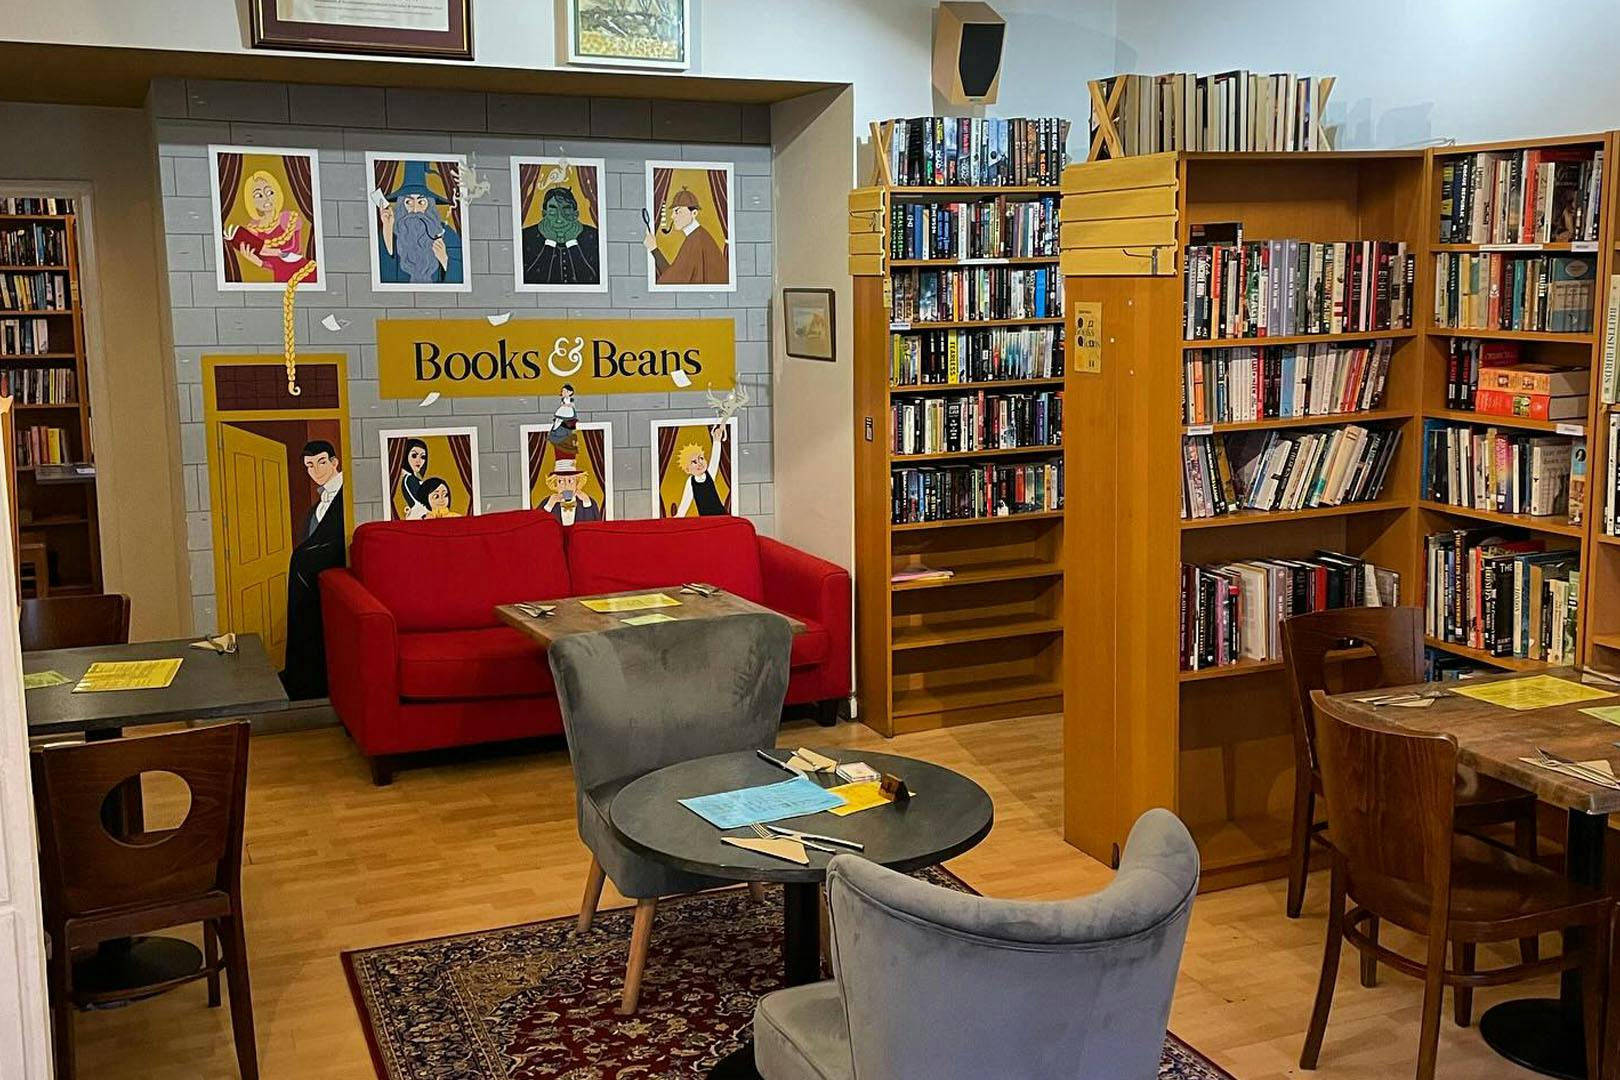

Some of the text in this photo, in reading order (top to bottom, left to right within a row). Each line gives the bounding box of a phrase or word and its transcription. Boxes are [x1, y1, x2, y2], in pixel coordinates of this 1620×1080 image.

[1459, 164, 1469, 218] ROGUE REPUBLIC
[413, 336, 703, 382] Books & Beans
[1604, 307, 1617, 384] BRITISH BIRDS
